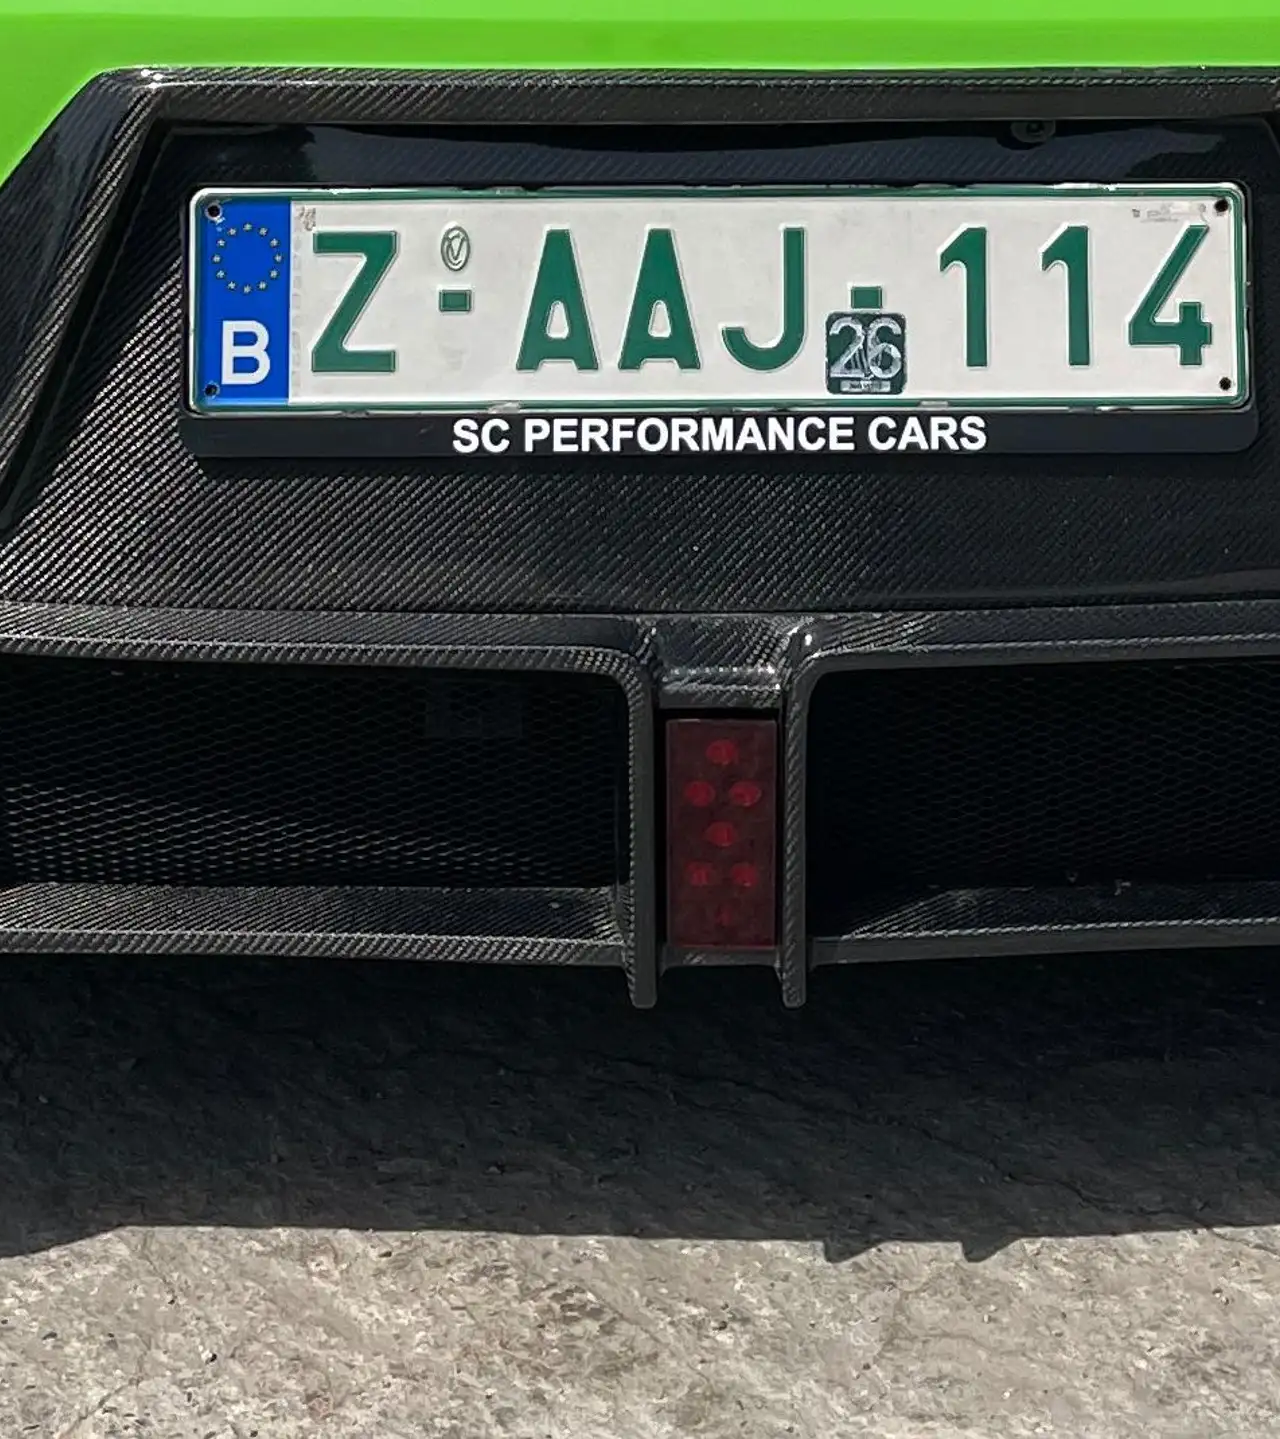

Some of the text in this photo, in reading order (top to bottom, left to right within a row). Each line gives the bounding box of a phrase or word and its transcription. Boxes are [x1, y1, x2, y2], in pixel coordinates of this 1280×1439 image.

[220, 320, 271, 385] B
[828, 317, 902, 378] 26
[452, 415, 988, 454] SC PERFORMANCE CARS
